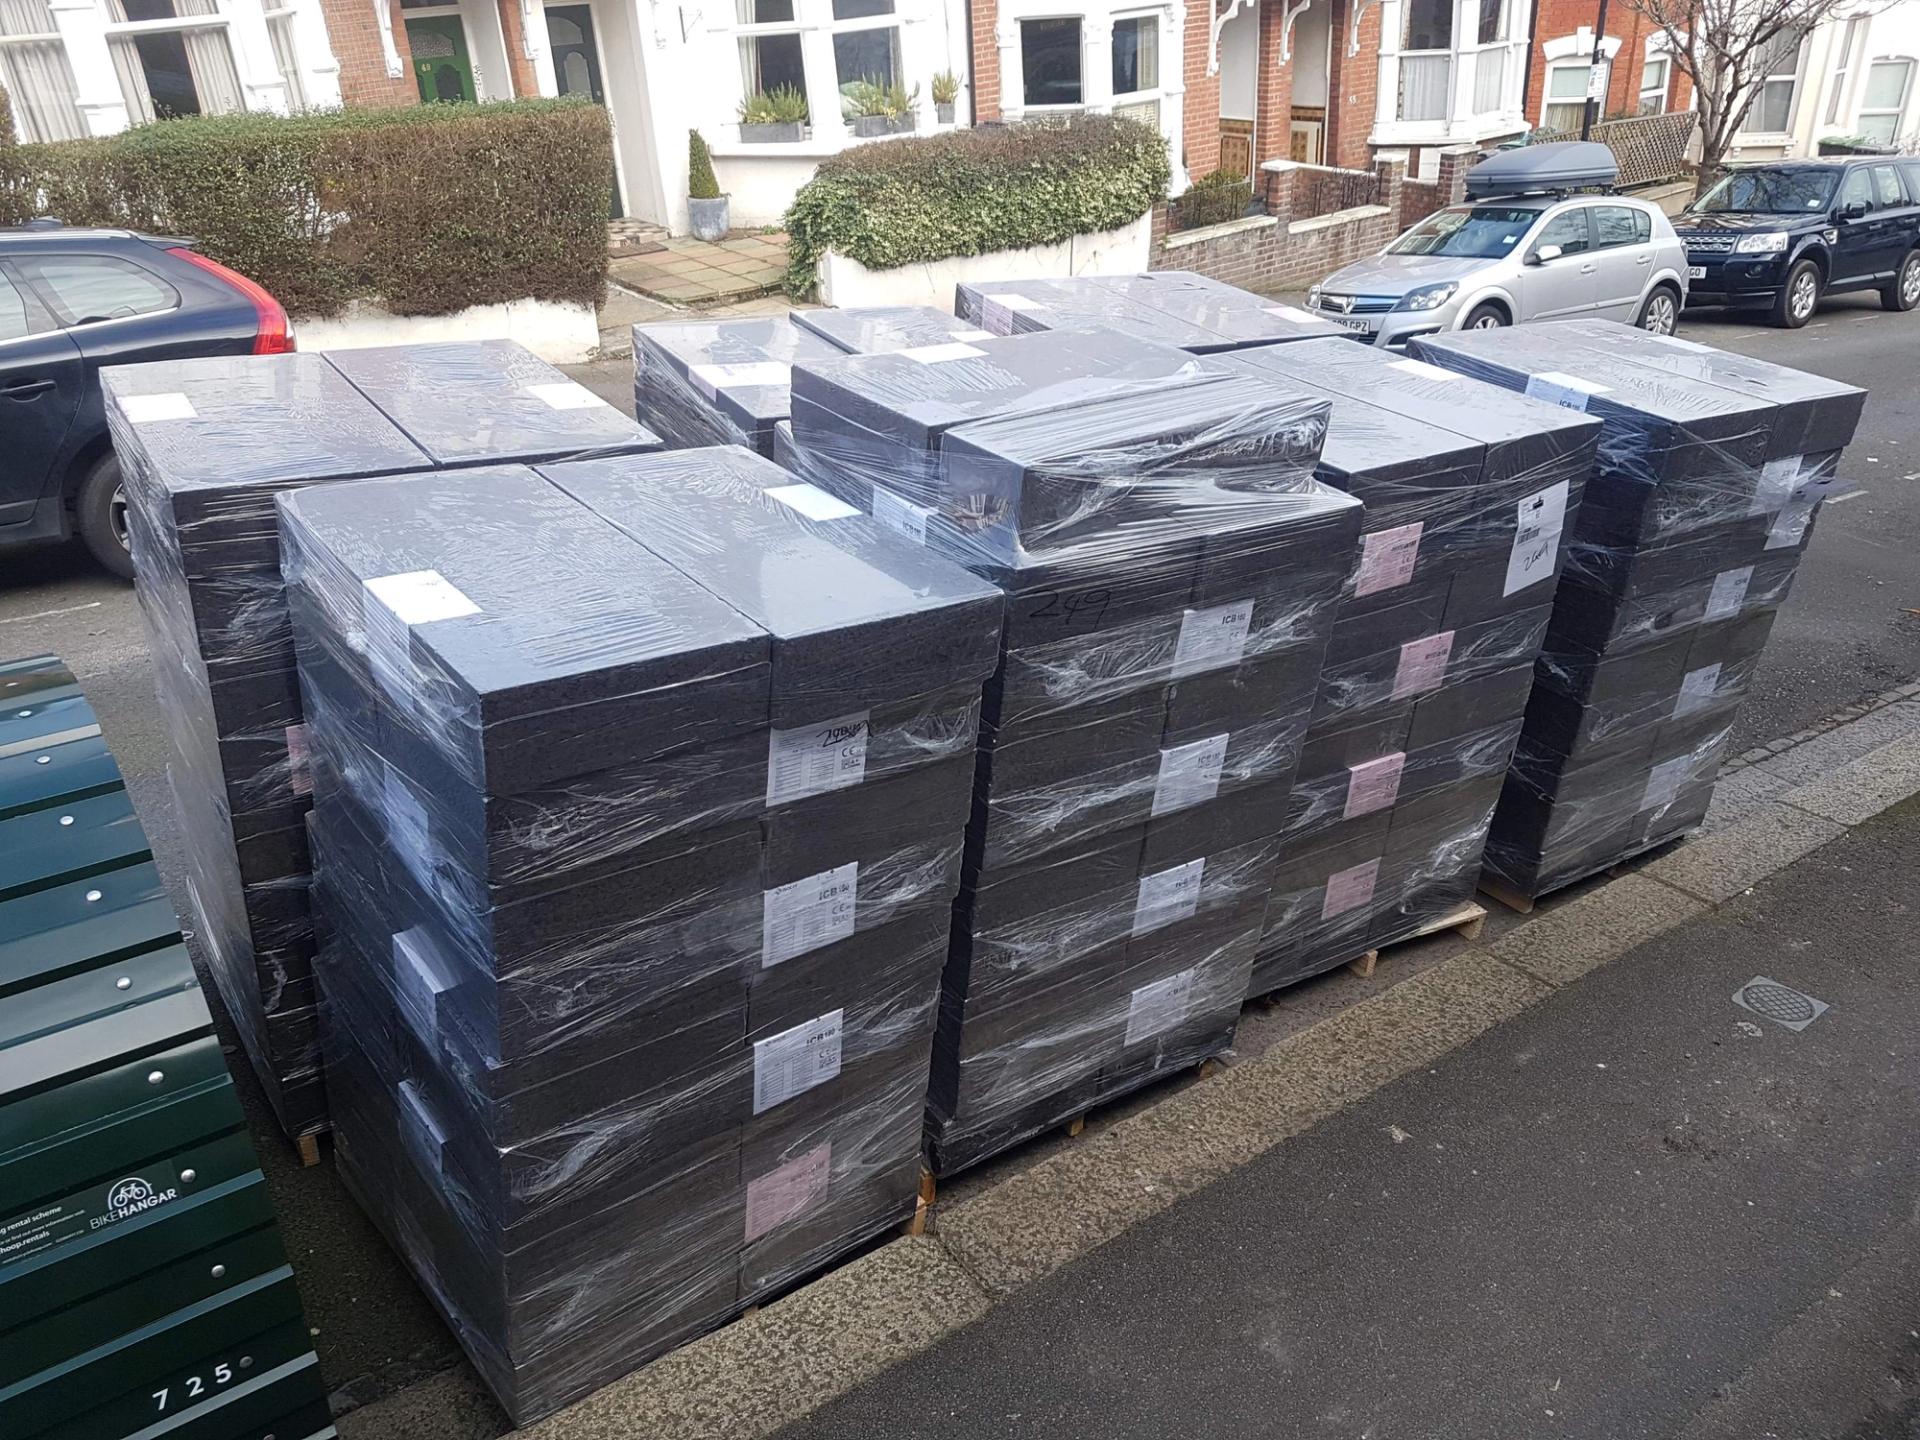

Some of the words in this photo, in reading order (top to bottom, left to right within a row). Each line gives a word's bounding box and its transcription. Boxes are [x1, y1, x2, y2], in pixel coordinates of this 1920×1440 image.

[7, 1216, 31, 1231] rental
[32, 1206, 62, 1222] scheme
[90, 1188, 177, 1230] BIKEHANGAR
[0, 1230, 50, 1255] hoop.rentals
